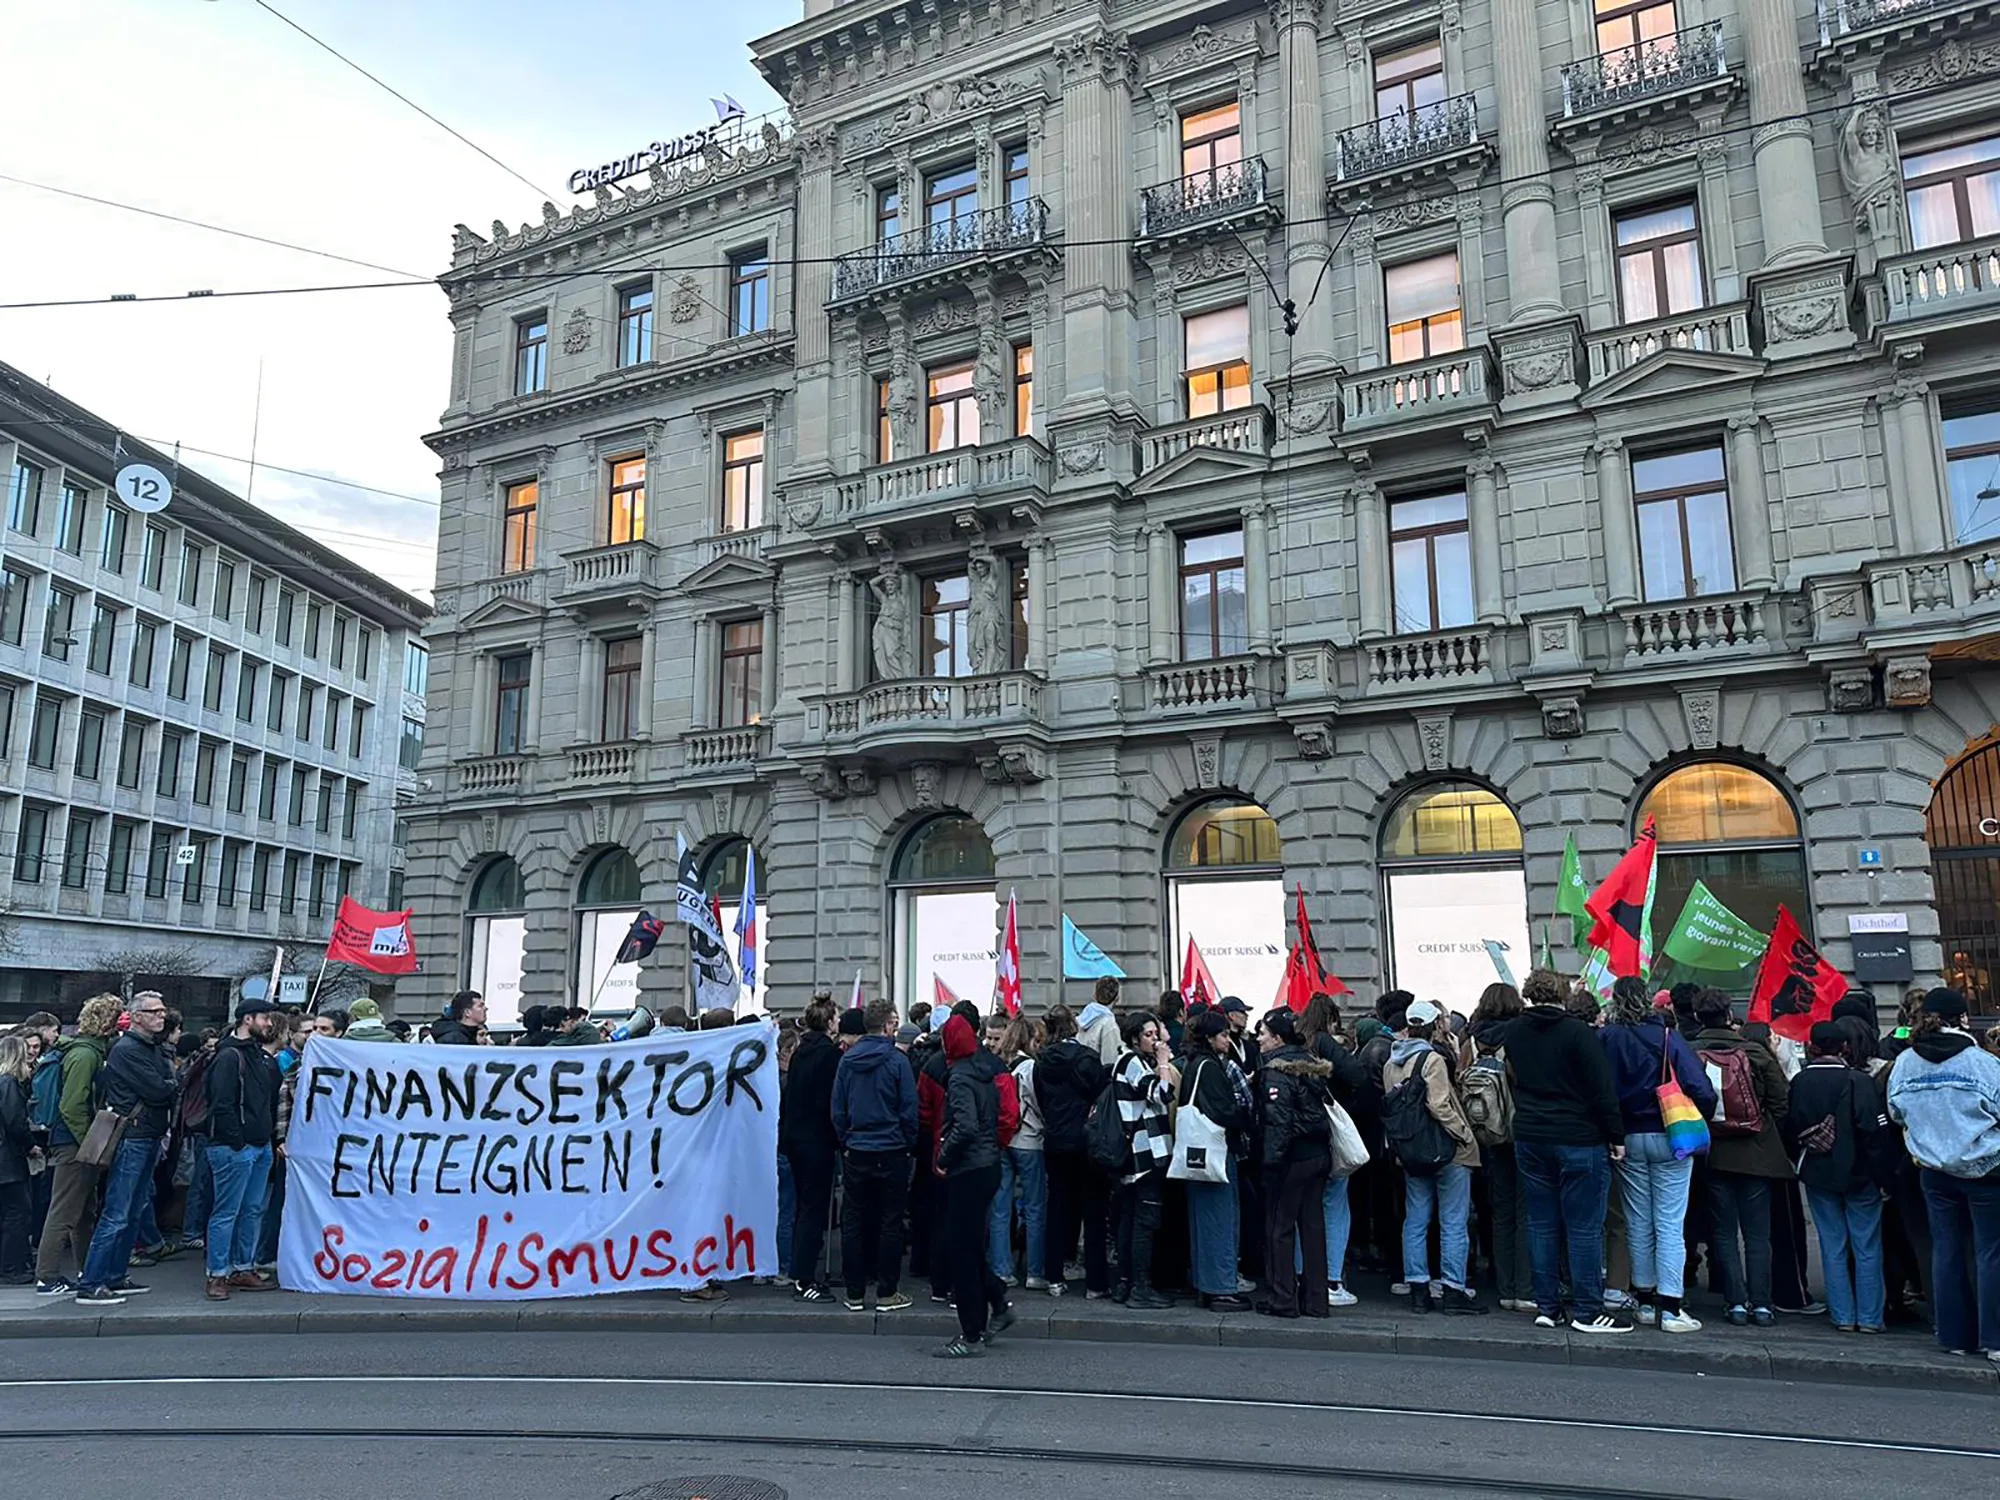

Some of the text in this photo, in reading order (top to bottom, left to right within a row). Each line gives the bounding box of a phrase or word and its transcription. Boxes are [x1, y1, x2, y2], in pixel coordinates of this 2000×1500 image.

[567, 127, 718, 194] CREDIT SUISSE
[128, 476, 160, 502] 12
[179, 849, 194, 860] 42
[1866, 851, 1873, 862] 8
[1692, 910, 1735, 936] jeunes
[1685, 925, 1731, 947] giovani
[932, 951, 986, 962] CREDIT SUISSE
[1200, 946, 1265, 957] CREDIT SUISSE
[1418, 943, 1488, 954] CREDIT SUISS
[284, 981, 305, 991] TAXI
[304, 1039, 768, 1126] FINANZSEKTOR
[313, 1212, 756, 1293] Sozialismus.ch
